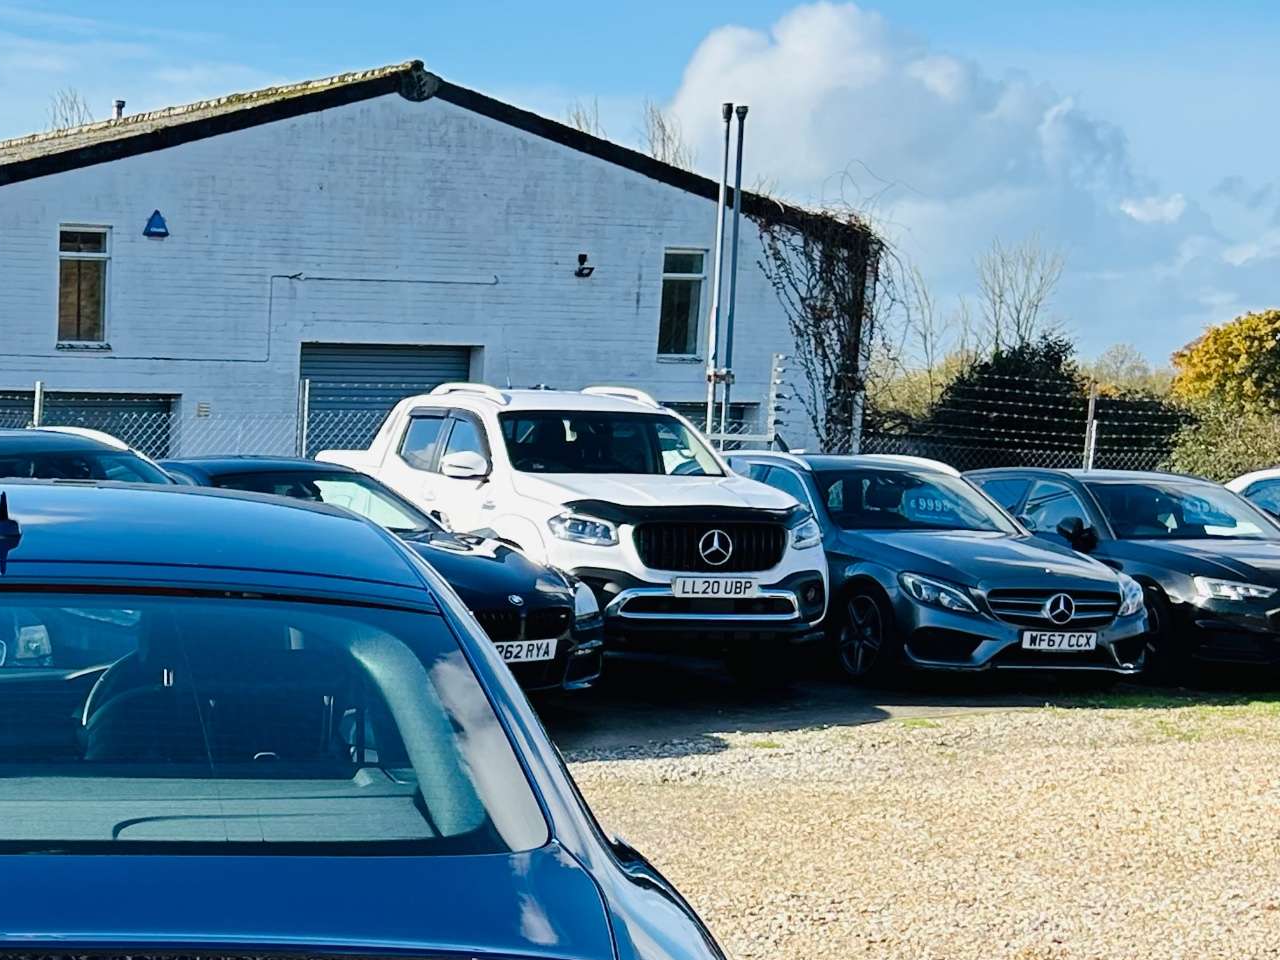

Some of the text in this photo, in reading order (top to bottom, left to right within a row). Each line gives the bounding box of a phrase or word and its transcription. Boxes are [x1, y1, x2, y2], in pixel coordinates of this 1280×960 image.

[681, 580, 753, 595] LL20 UBP
[1029, 633, 1093, 648] WF67 CCX
[526, 642, 551, 658] RYA
